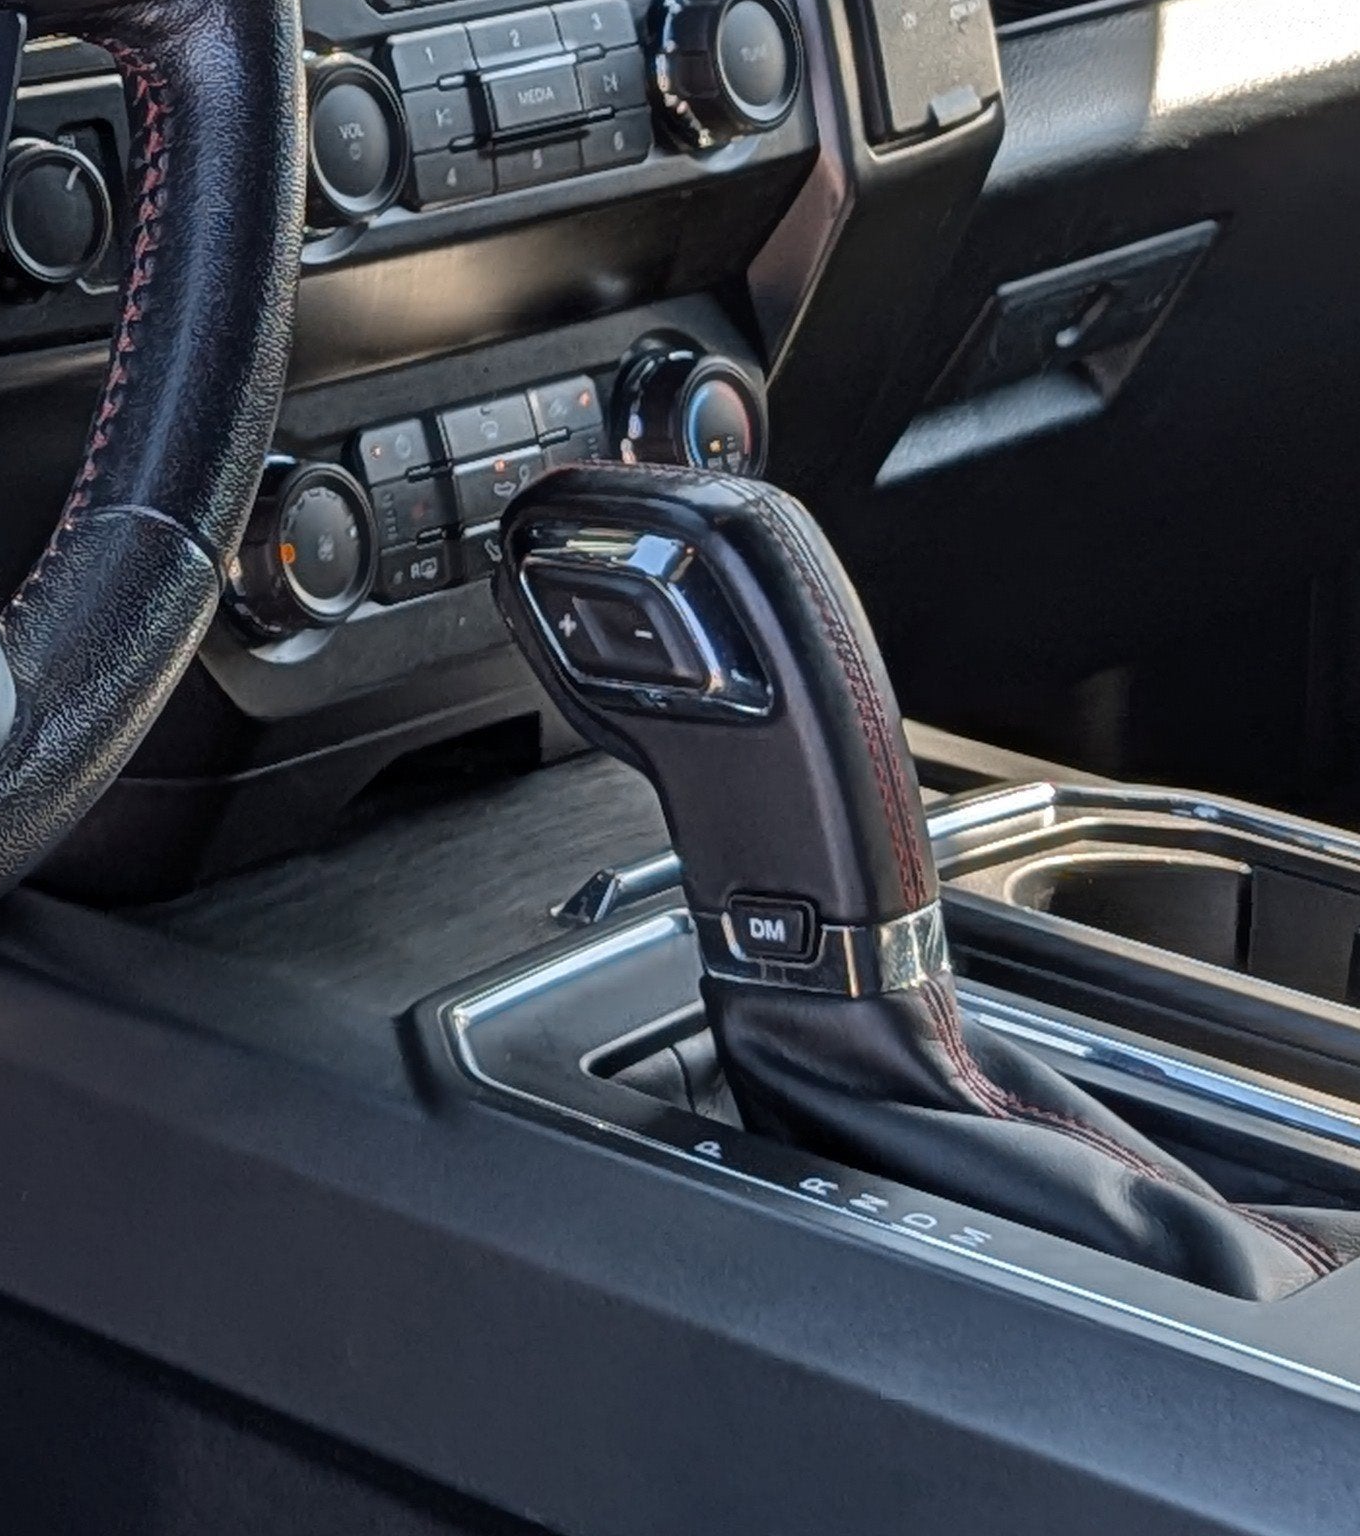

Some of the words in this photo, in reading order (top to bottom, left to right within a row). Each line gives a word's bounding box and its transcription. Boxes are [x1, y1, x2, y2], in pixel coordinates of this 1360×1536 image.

[591, 13, 603, 30] 3
[509, 29, 521, 47] 2
[518, 86, 555, 105] MEDIA
[339, 122, 366, 141] VOL
[446, 167, 457, 187] 4
[748, 917, 786, 943] DM
[694, 1140, 723, 1159] P
[799, 1177, 839, 1196] R
[850, 1192, 890, 1213] N
[902, 1212, 938, 1229] D
